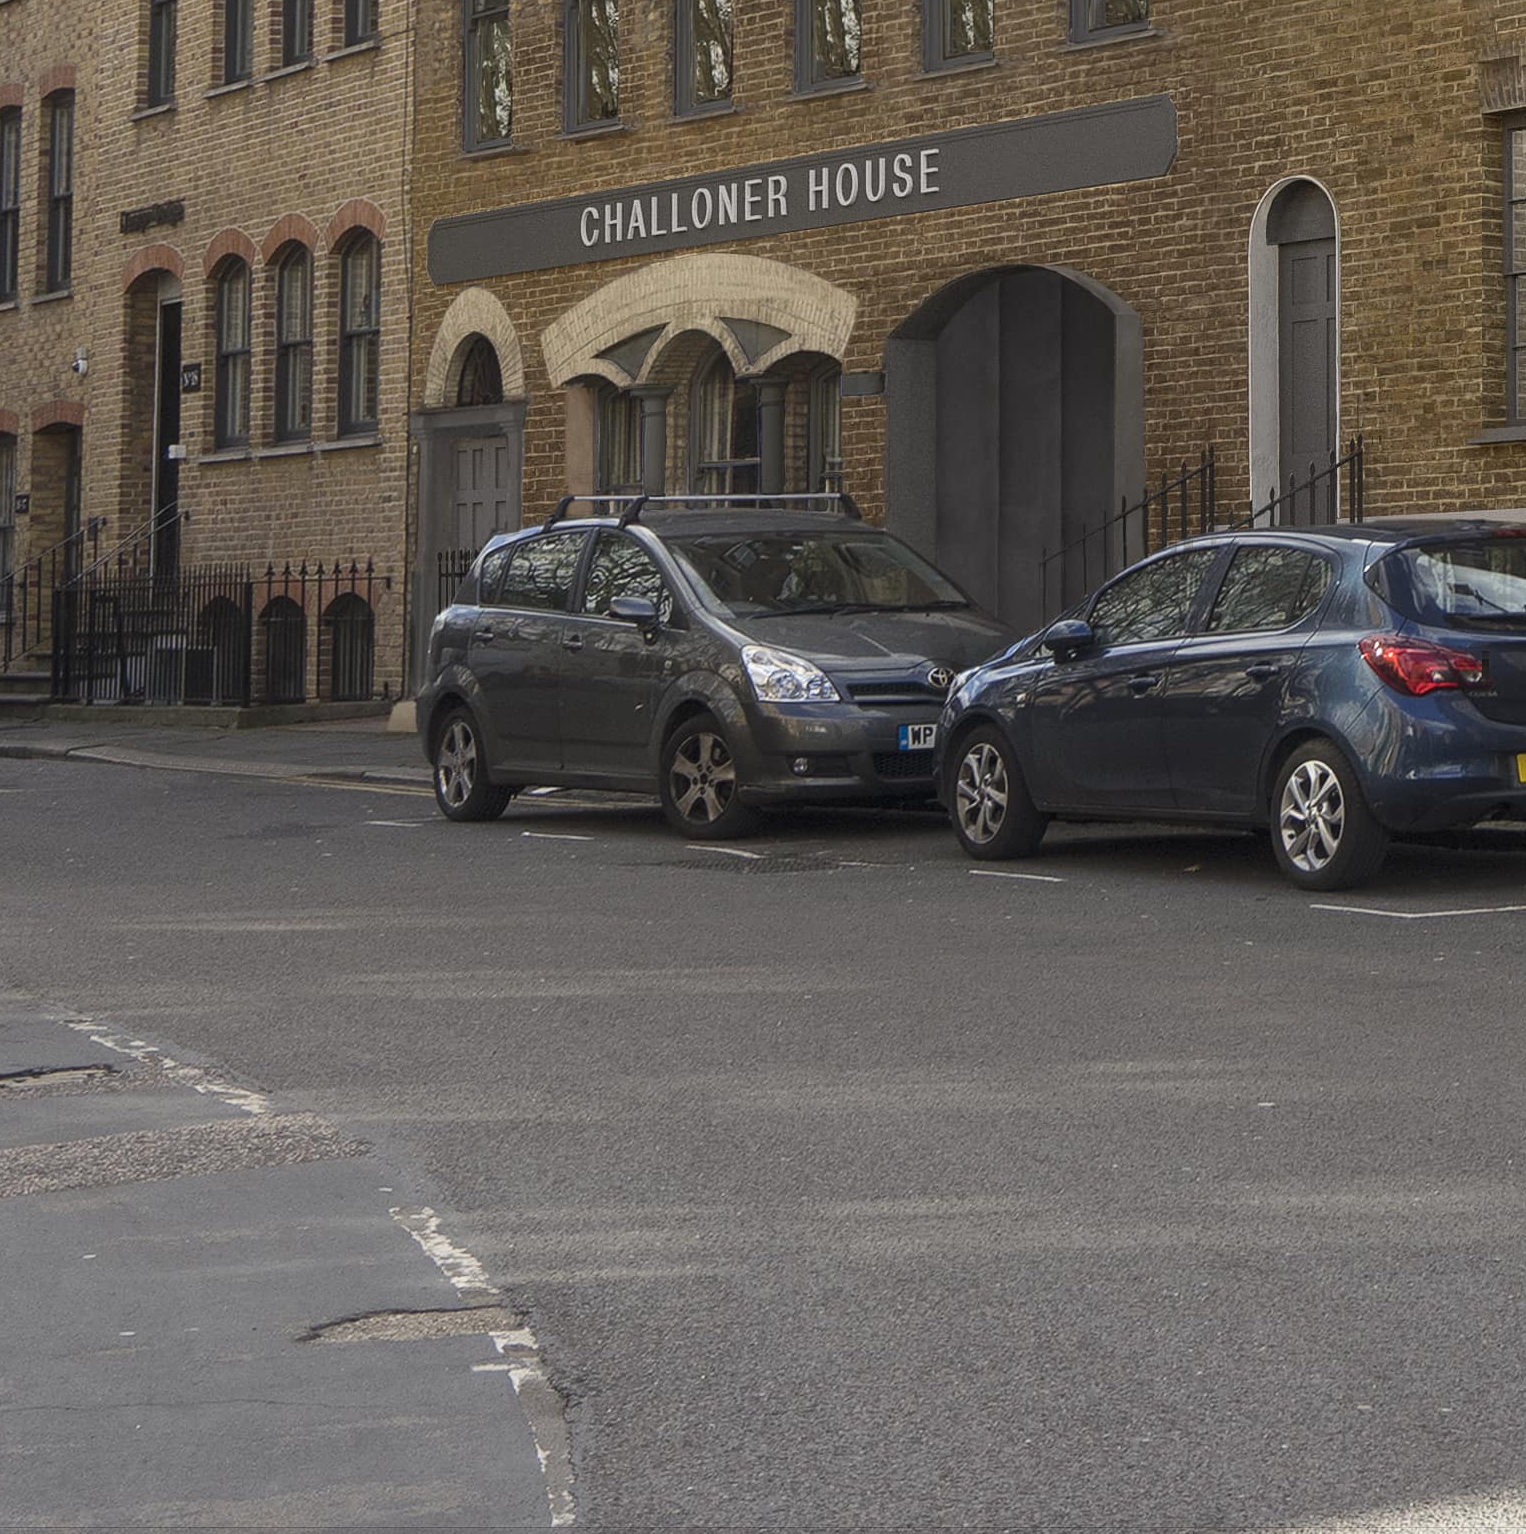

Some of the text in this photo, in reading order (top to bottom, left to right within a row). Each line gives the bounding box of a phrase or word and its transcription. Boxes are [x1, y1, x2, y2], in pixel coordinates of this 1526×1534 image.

[580, 148, 940, 247] CHALLONER HOUSE
[910, 726, 934, 746] WP
